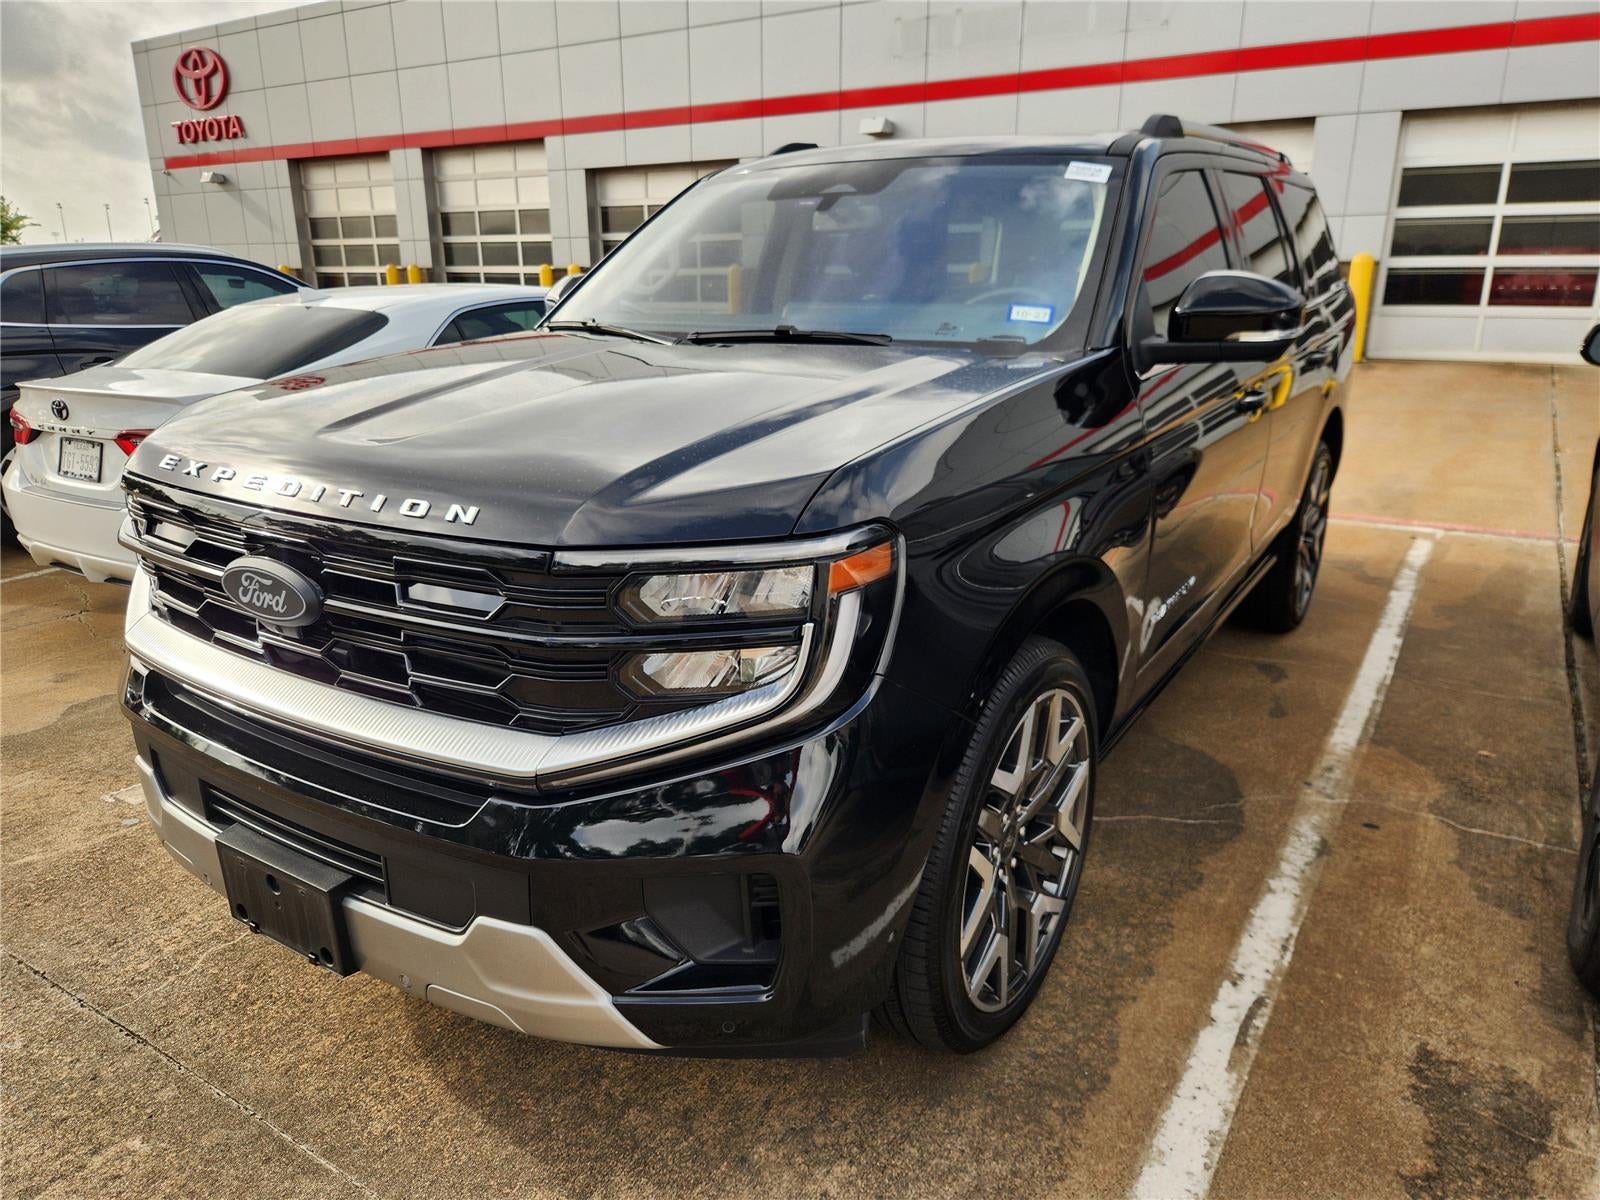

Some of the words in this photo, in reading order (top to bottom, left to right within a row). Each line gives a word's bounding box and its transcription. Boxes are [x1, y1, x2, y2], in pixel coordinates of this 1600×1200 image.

[171, 115, 247, 144] TOYOTA
[158, 454, 481, 525] EXPEDITION
[238, 571, 288, 614] Ford
